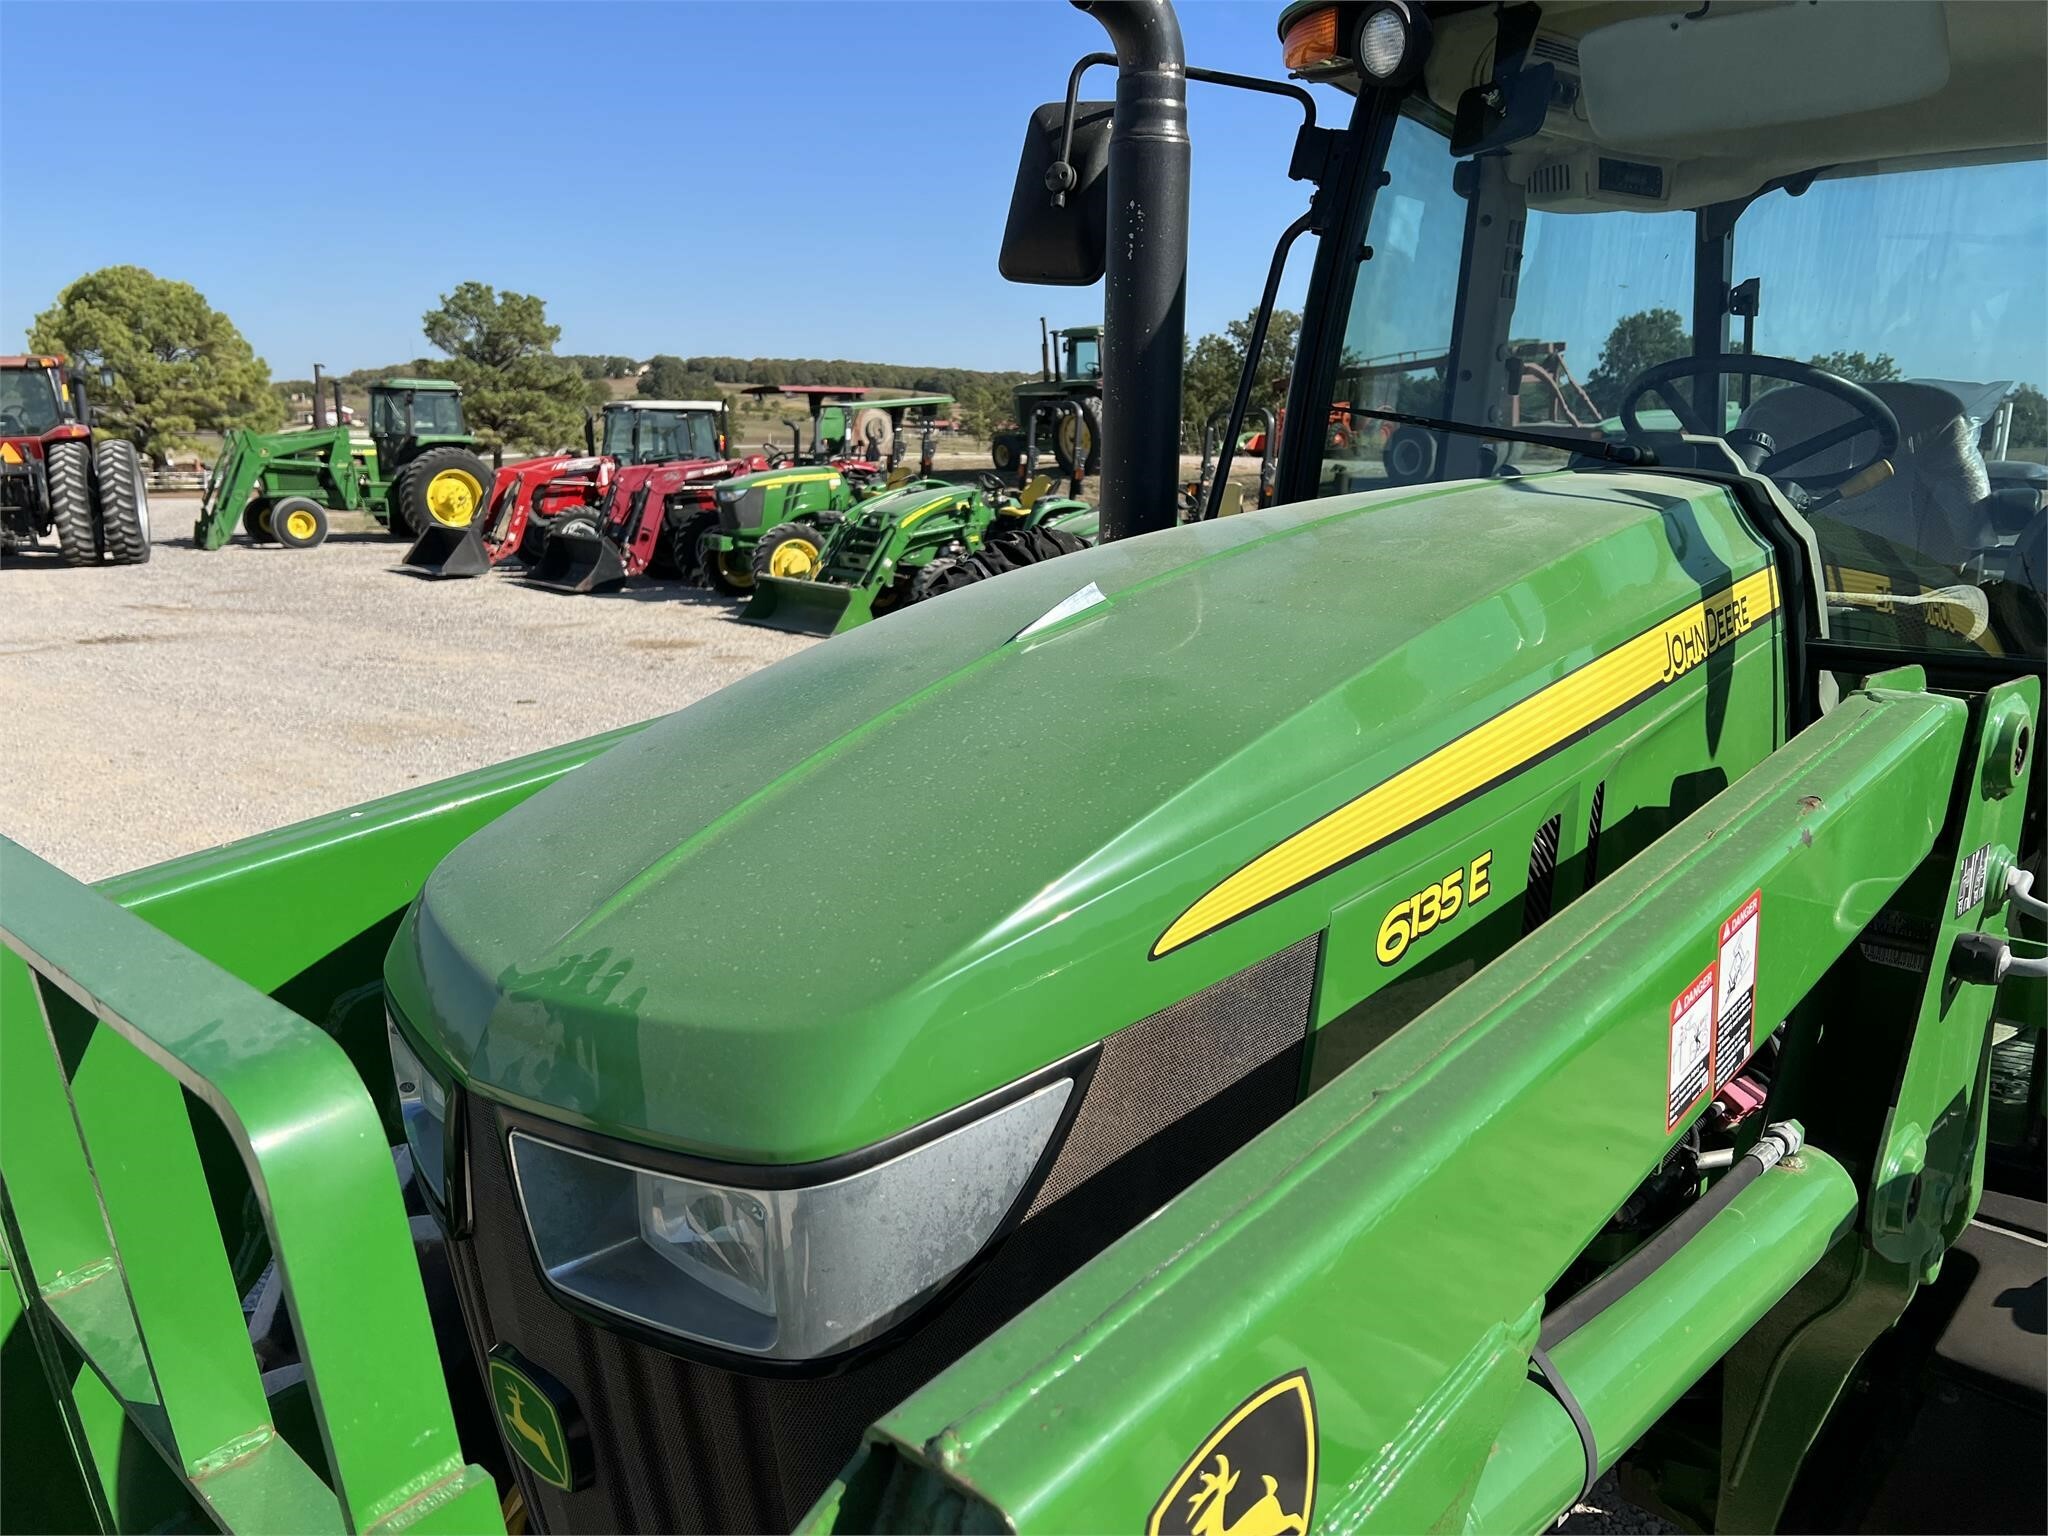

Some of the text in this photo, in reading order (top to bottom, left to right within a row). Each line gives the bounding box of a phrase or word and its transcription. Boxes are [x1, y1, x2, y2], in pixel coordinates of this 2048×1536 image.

[1663, 596, 1750, 677] JOHN DEERE
[1376, 848, 1493, 967] 6135 E
[1730, 897, 1759, 930] DANGER
[1683, 970, 1714, 1007] DANGER
